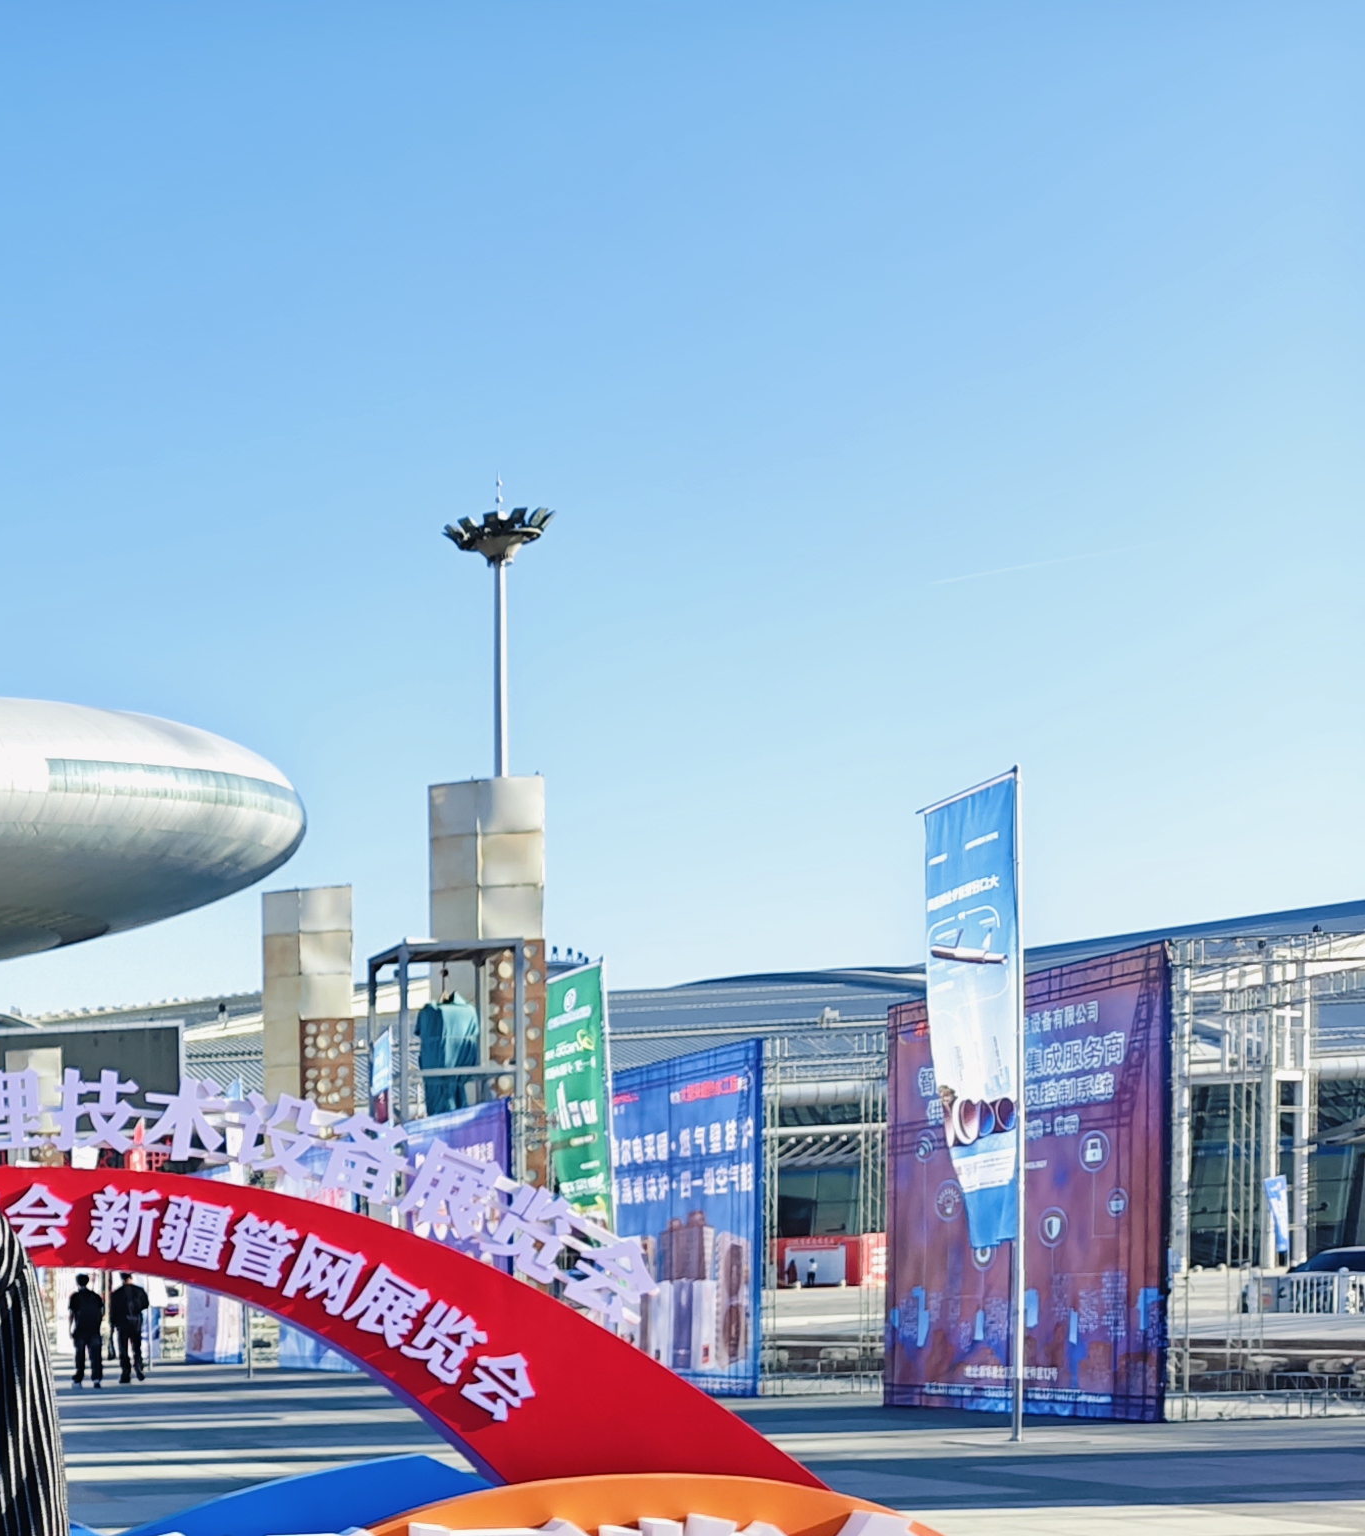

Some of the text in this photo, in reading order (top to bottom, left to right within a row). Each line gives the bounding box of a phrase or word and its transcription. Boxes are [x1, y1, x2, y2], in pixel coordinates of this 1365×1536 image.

[87, 1184, 536, 1424] 新疆管网展览会
